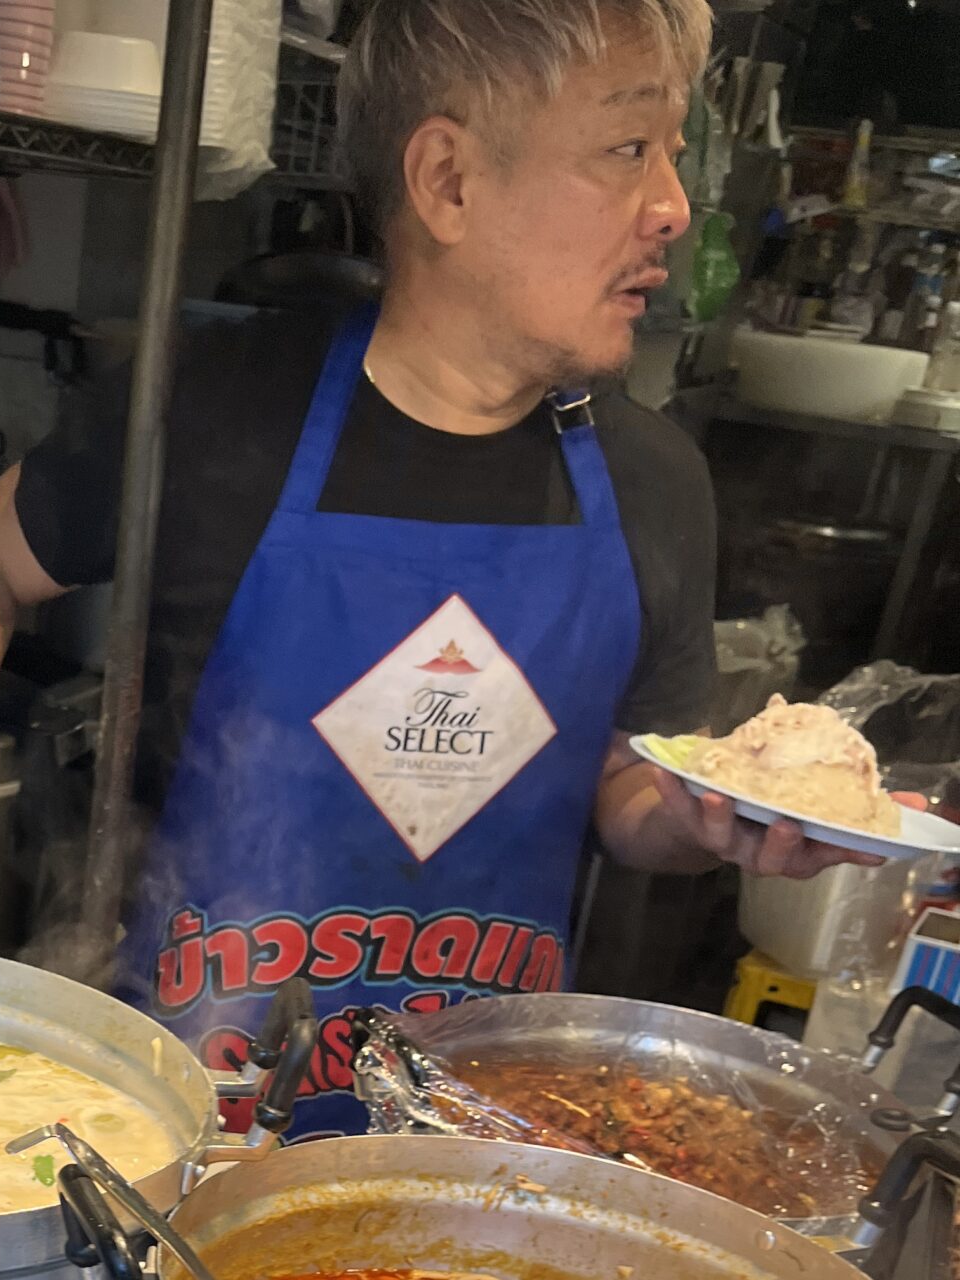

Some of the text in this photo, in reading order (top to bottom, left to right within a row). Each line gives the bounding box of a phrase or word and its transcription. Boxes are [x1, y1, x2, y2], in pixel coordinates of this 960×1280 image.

[405, 687, 481, 729] Thai
[384, 726, 495, 756] SELECT
[156, 910, 565, 1008] ข้าวราดแก
